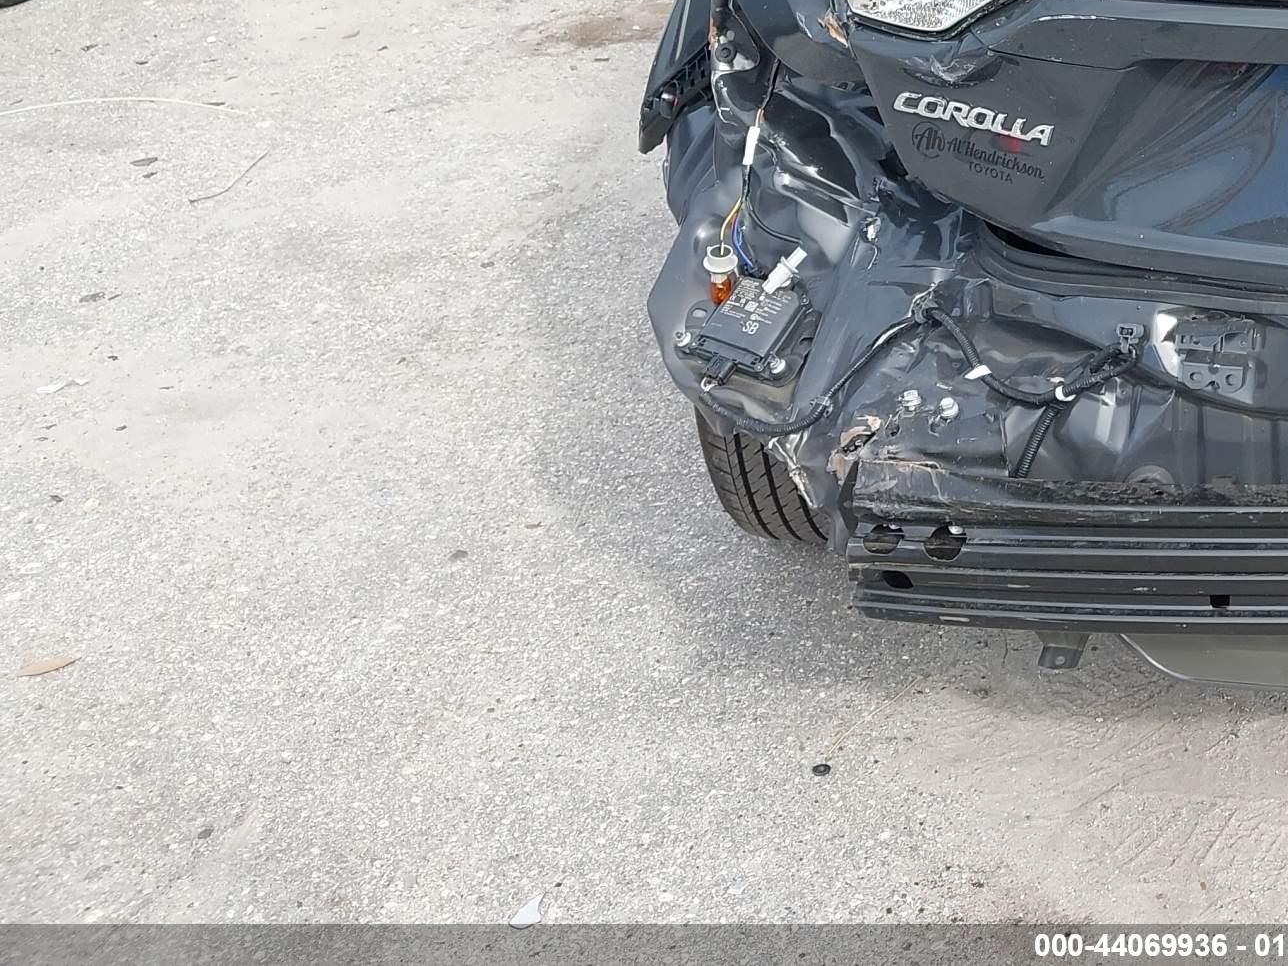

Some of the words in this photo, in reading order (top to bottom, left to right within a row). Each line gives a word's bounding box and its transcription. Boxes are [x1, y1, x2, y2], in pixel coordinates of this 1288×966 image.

[893, 90, 1055, 147] COROLLA
[964, 141, 1046, 180] Hendrickson
[968, 160, 1014, 184] TOYOTA
